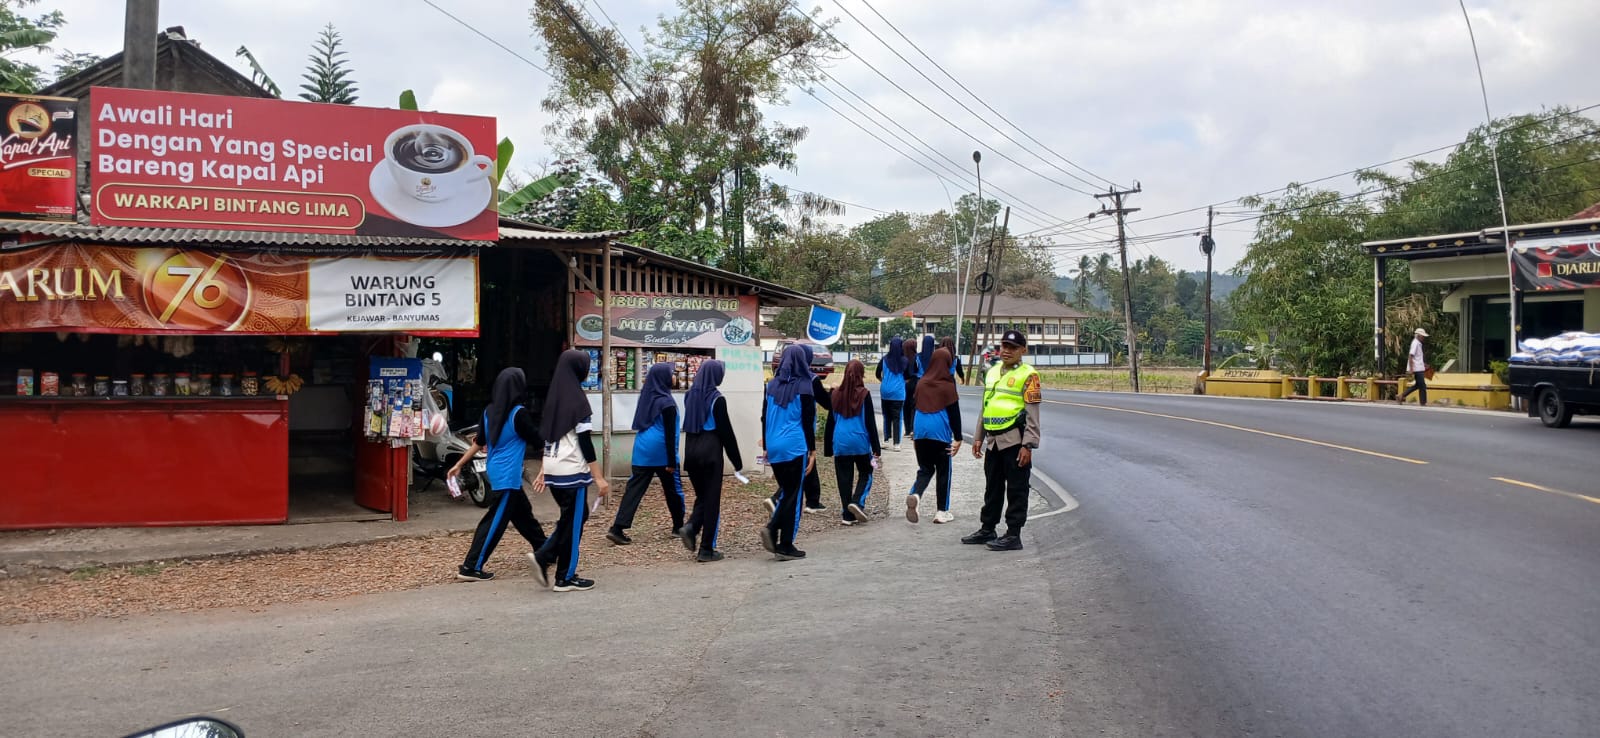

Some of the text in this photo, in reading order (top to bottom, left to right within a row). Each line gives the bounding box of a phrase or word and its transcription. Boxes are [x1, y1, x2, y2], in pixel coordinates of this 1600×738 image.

[97, 103, 172, 126] Awali
[179, 108, 233, 129] Hari
[37, 131, 72, 157] Api
[98, 128, 373, 165] Dengan Yang Special
[31, 168, 66, 177] SPECIAL
[98, 153, 324, 189] Bareng Kapal Api
[114, 192, 349, 217] WARKAPI BINTANG LIMA
[1556, 262, 1600, 276] DJARU
[158, 252, 229, 322] 76
[350, 275, 436, 290] WARUNG
[345, 292, 441, 307] BINTANG 5
[346, 314, 386, 322] KEJAWAR
[392, 314, 440, 322] BANYUMAS
[617, 318, 717, 333] MIE AYAM
[644, 334, 681, 345] Bintang
